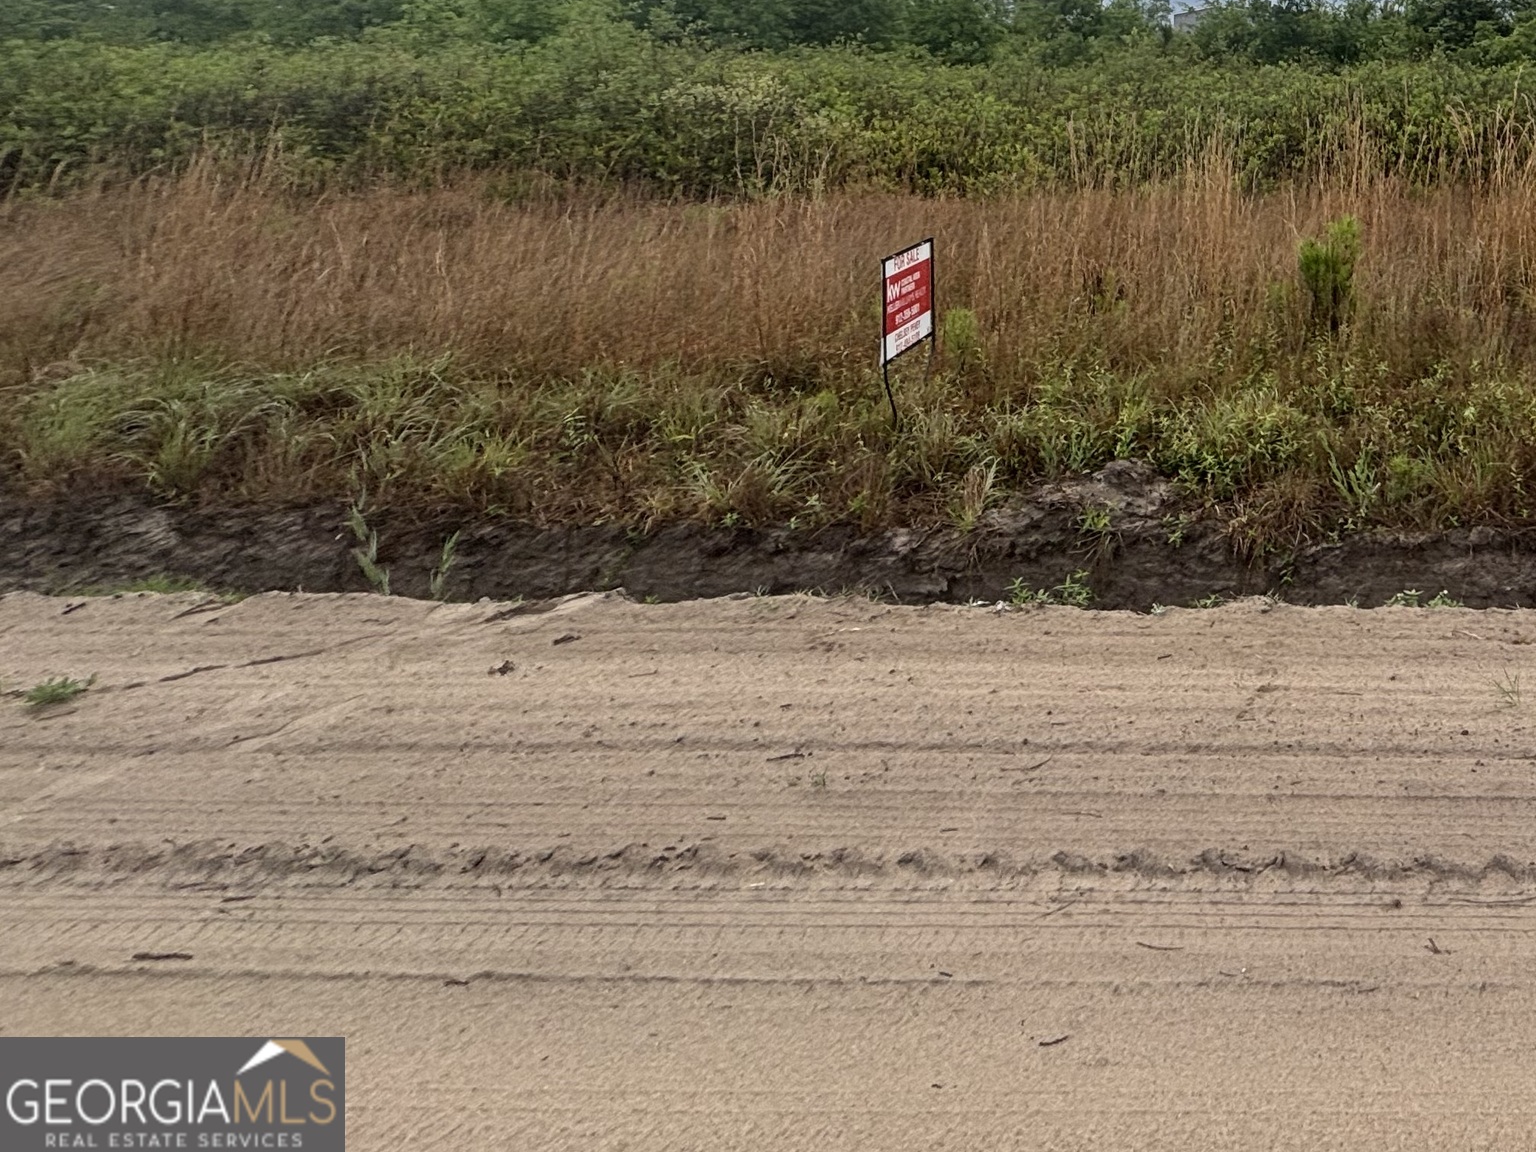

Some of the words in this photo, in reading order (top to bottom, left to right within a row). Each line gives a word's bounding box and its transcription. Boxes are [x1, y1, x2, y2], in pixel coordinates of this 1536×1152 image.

[893, 254, 905, 272] FOR
[906, 247, 920, 266] SALE
[886, 278, 901, 304] kw
